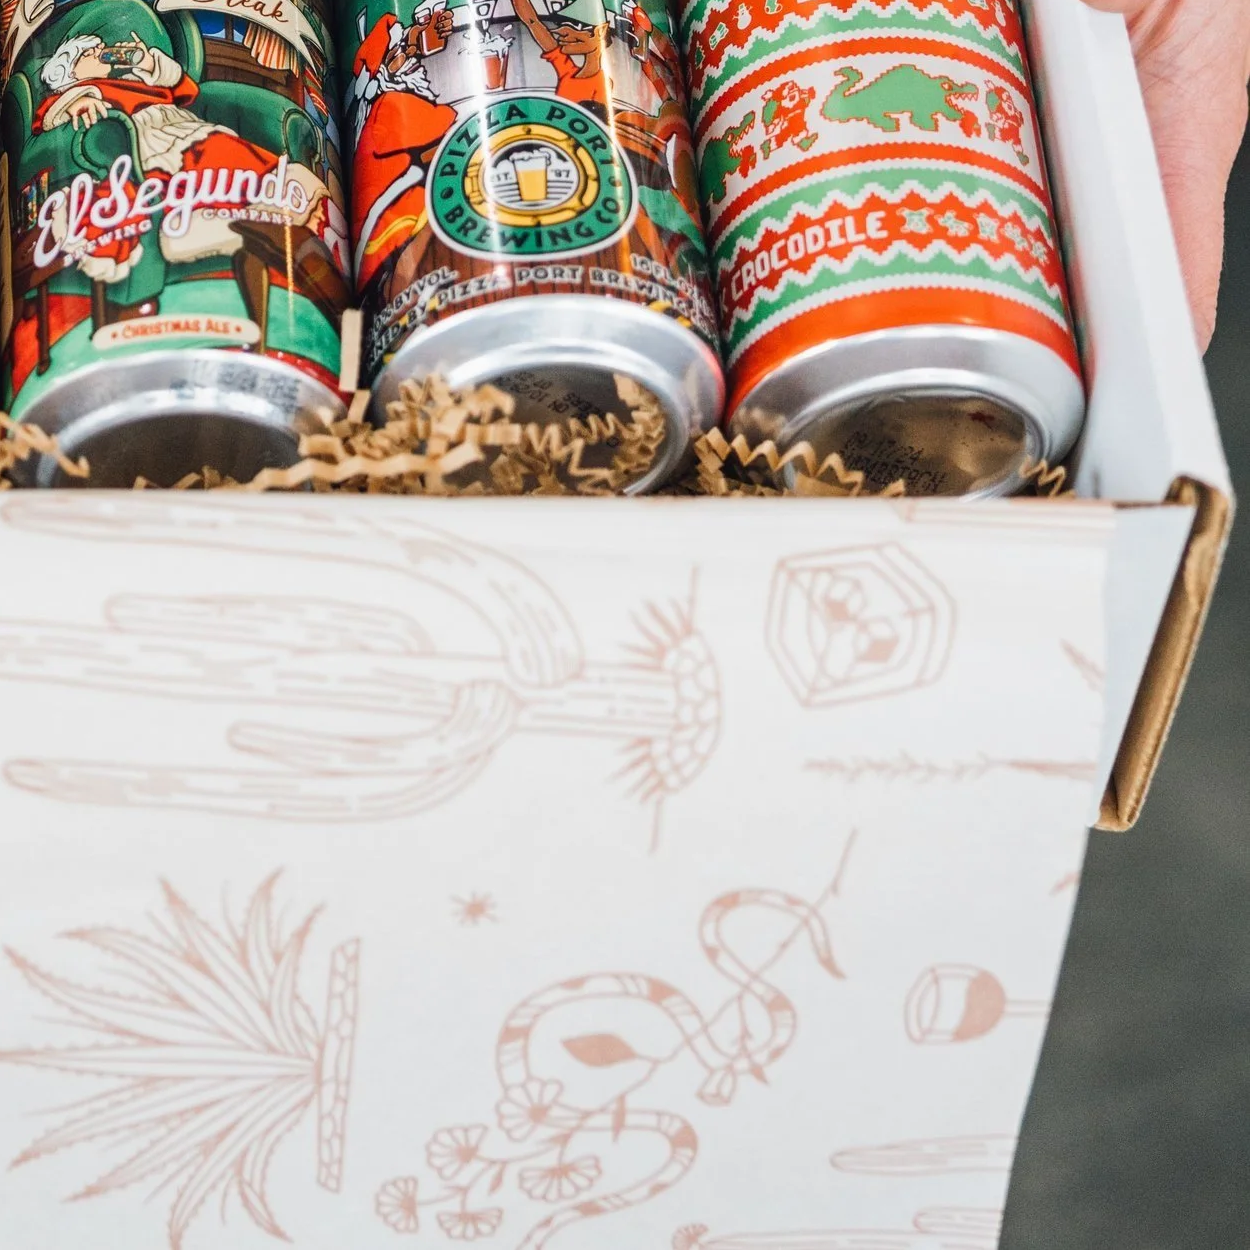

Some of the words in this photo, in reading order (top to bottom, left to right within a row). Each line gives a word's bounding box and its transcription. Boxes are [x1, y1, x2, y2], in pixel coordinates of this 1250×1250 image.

[33, 172, 94, 268] El
[90, 153, 310, 238] Segundo
[202, 207, 294, 227] COMPANY
[443, 204, 595, 249] BREWING
[515, 264, 583, 287] PORT
[730, 210, 889, 301] CROCODILE
